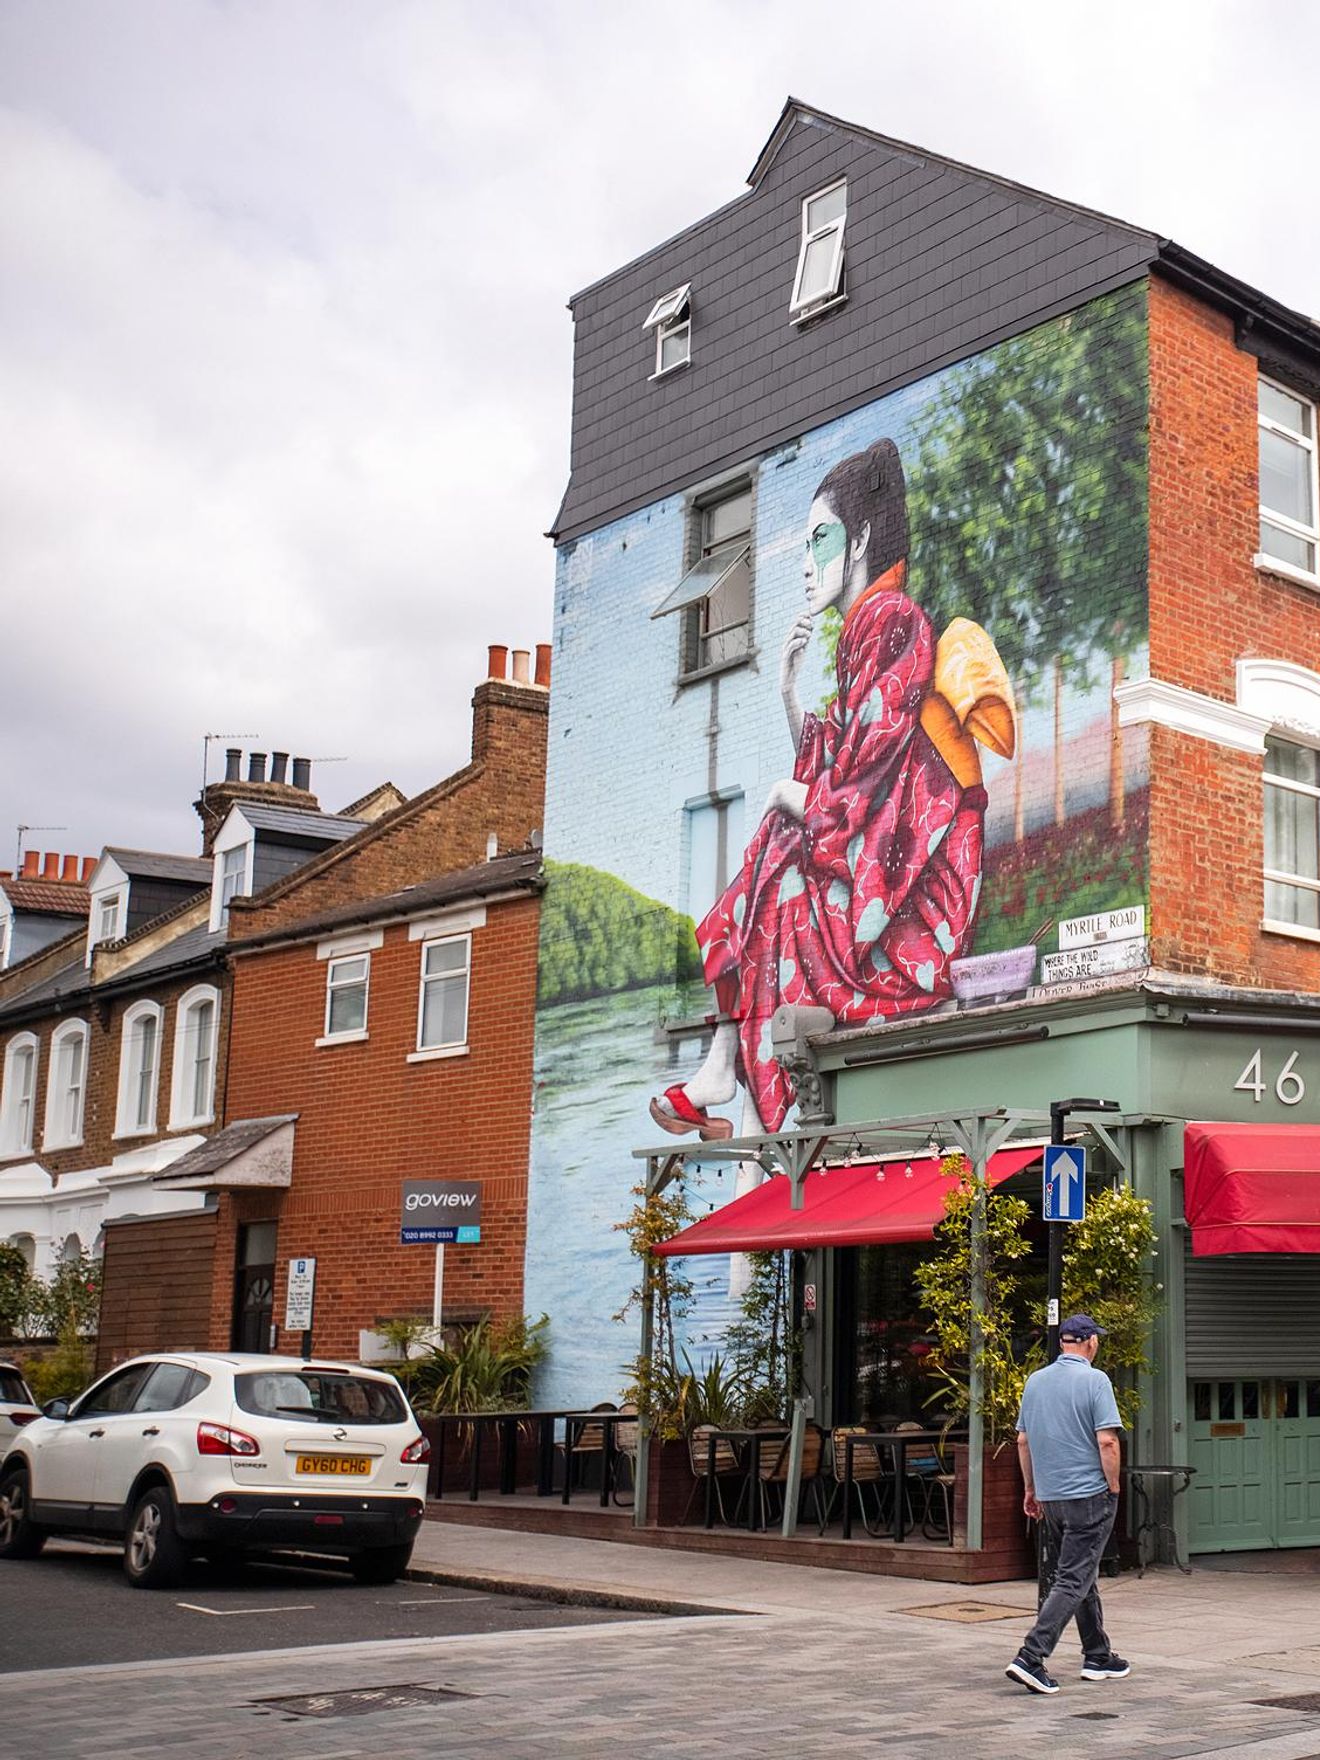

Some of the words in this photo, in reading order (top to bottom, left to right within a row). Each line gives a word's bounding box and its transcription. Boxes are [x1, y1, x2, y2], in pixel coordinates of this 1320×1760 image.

[1065, 917, 1101, 937] MYRTLE
[1109, 911, 1137, 929] ROAD
[1044, 954, 1065, 968] WHERE
[1066, 953, 1078, 964] THE
[1080, 950, 1099, 962] WILD
[1048, 964, 1074, 981] THINGS
[1076, 964, 1092, 977] ARE
[1233, 1047, 1305, 1105] 46
[405, 1193, 477, 1211] goview
[302, 1458, 338, 1472] GY60
[341, 1460, 366, 1473] CHG
